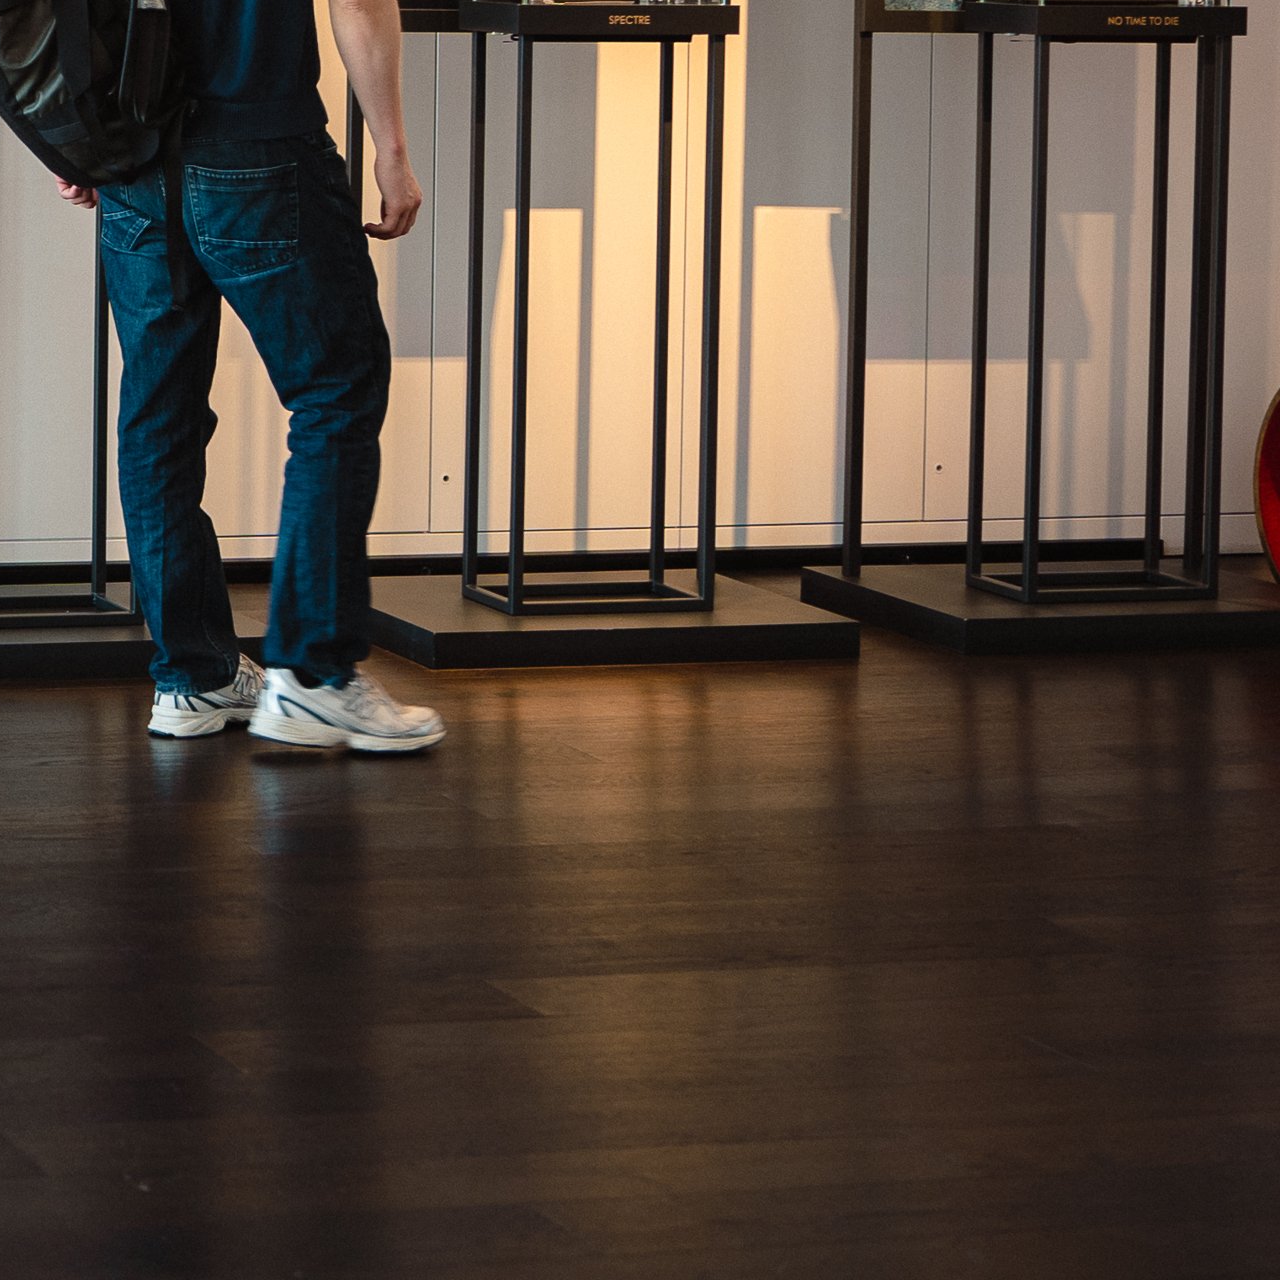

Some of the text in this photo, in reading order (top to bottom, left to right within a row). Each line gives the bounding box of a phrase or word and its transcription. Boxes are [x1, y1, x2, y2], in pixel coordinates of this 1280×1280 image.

[608, 15, 651, 25] SPECTRE
[1107, 16, 1179, 26] NO TIME TO DIE
